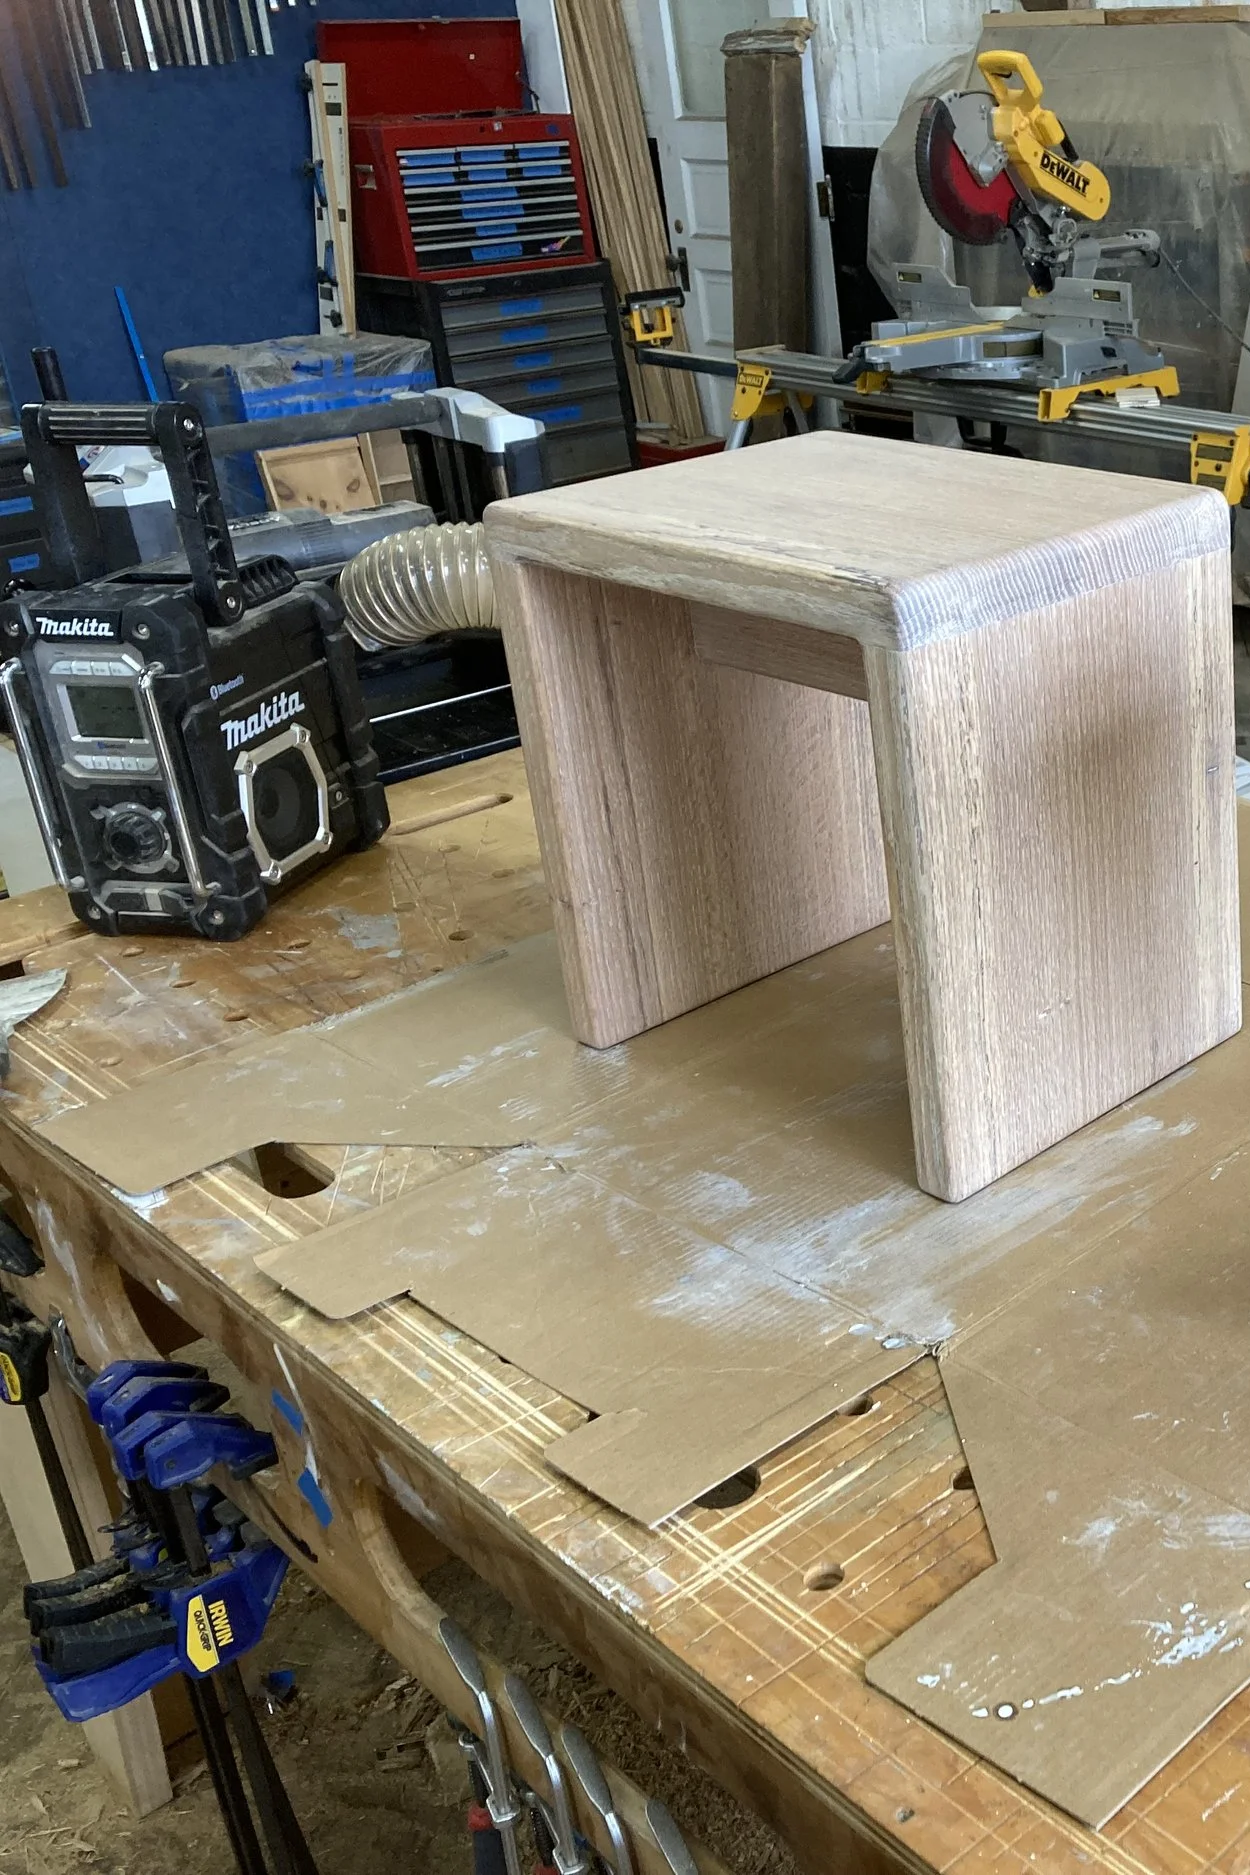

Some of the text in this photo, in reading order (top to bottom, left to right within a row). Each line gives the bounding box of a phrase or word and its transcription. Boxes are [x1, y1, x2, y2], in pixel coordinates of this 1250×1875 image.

[36, 617, 114, 636] Makita
[220, 691, 305, 751] Makita
[208, 1599, 234, 1647] IRWIN
